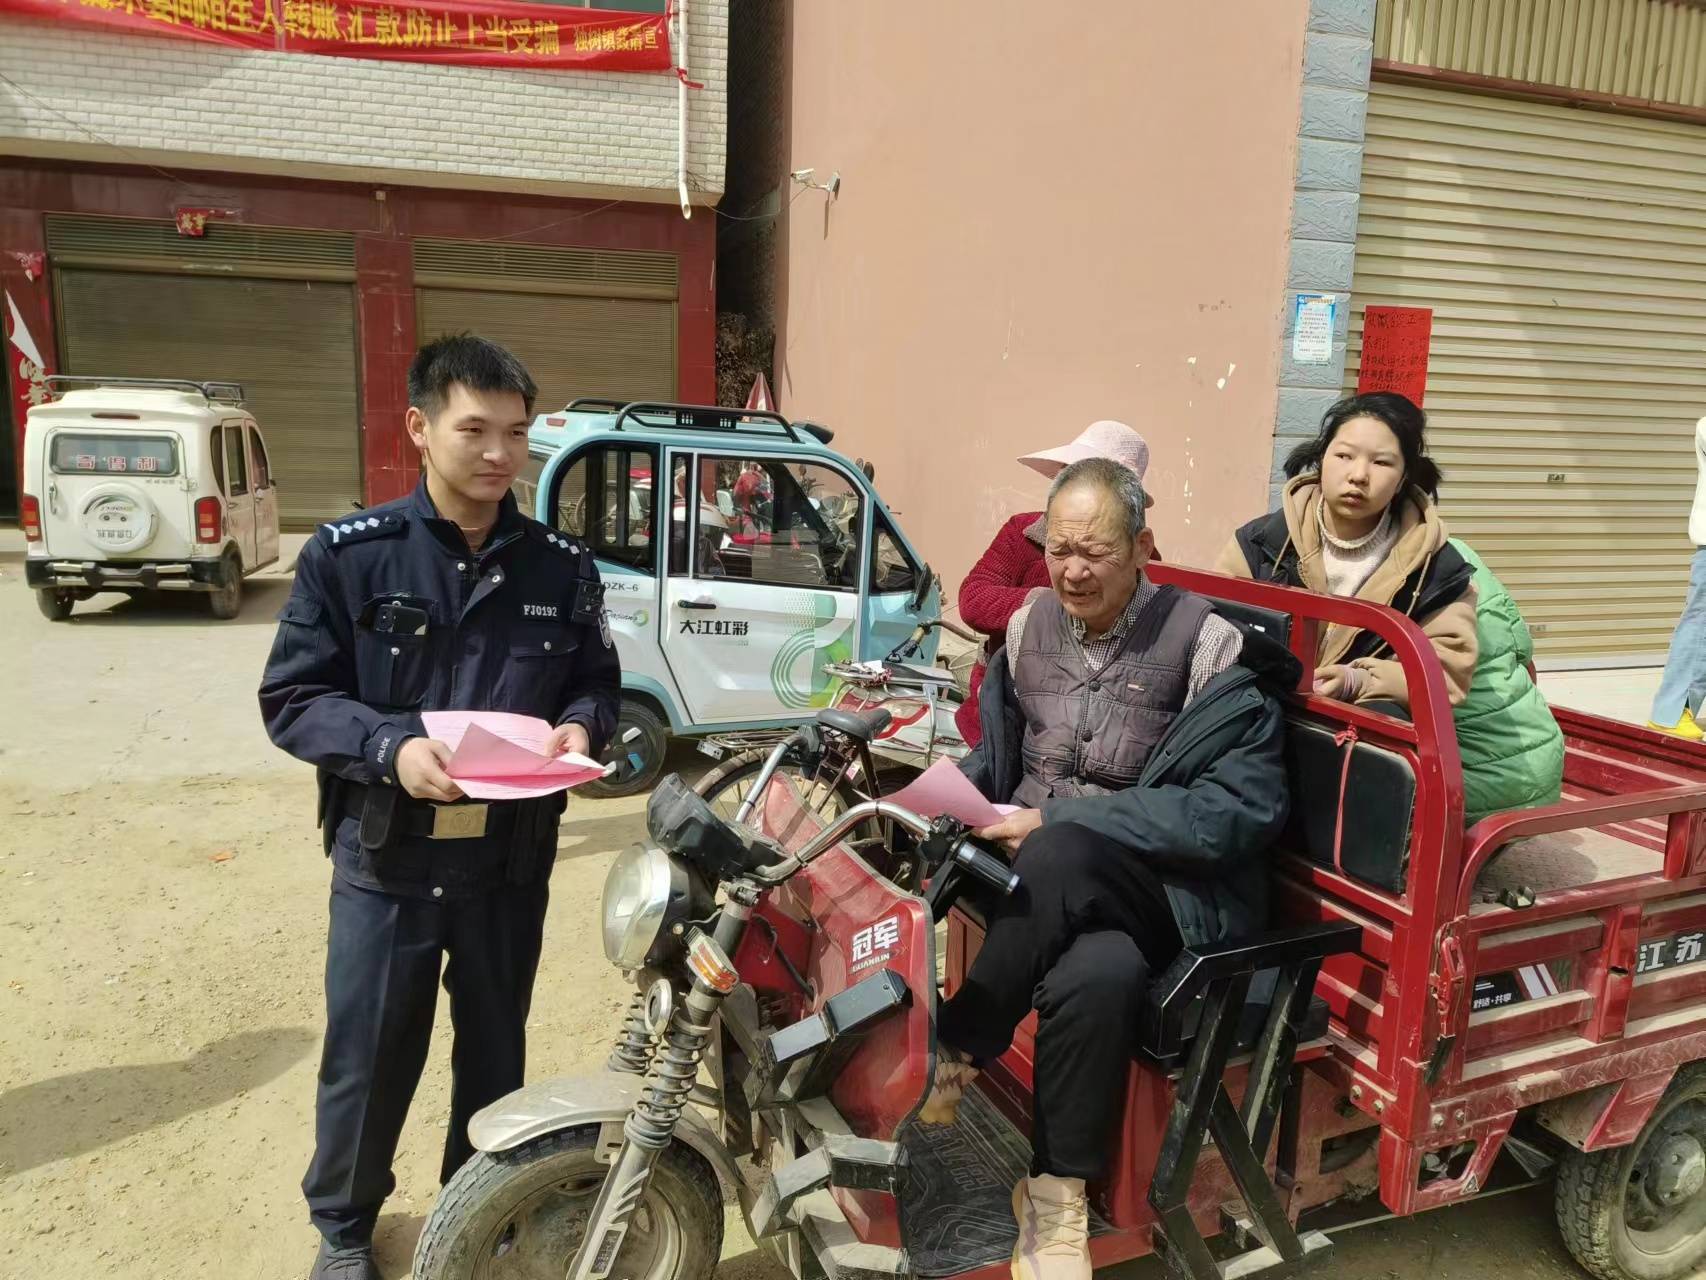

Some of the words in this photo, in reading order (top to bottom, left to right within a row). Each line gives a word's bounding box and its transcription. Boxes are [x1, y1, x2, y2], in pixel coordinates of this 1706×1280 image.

[523, 605, 558, 617] FJ0192
[680, 619, 749, 636] 大江虹彩
[377, 737, 391, 764] POLICE
[852, 916, 899, 962] 冠军
[1637, 933, 1703, 972] 江苏
